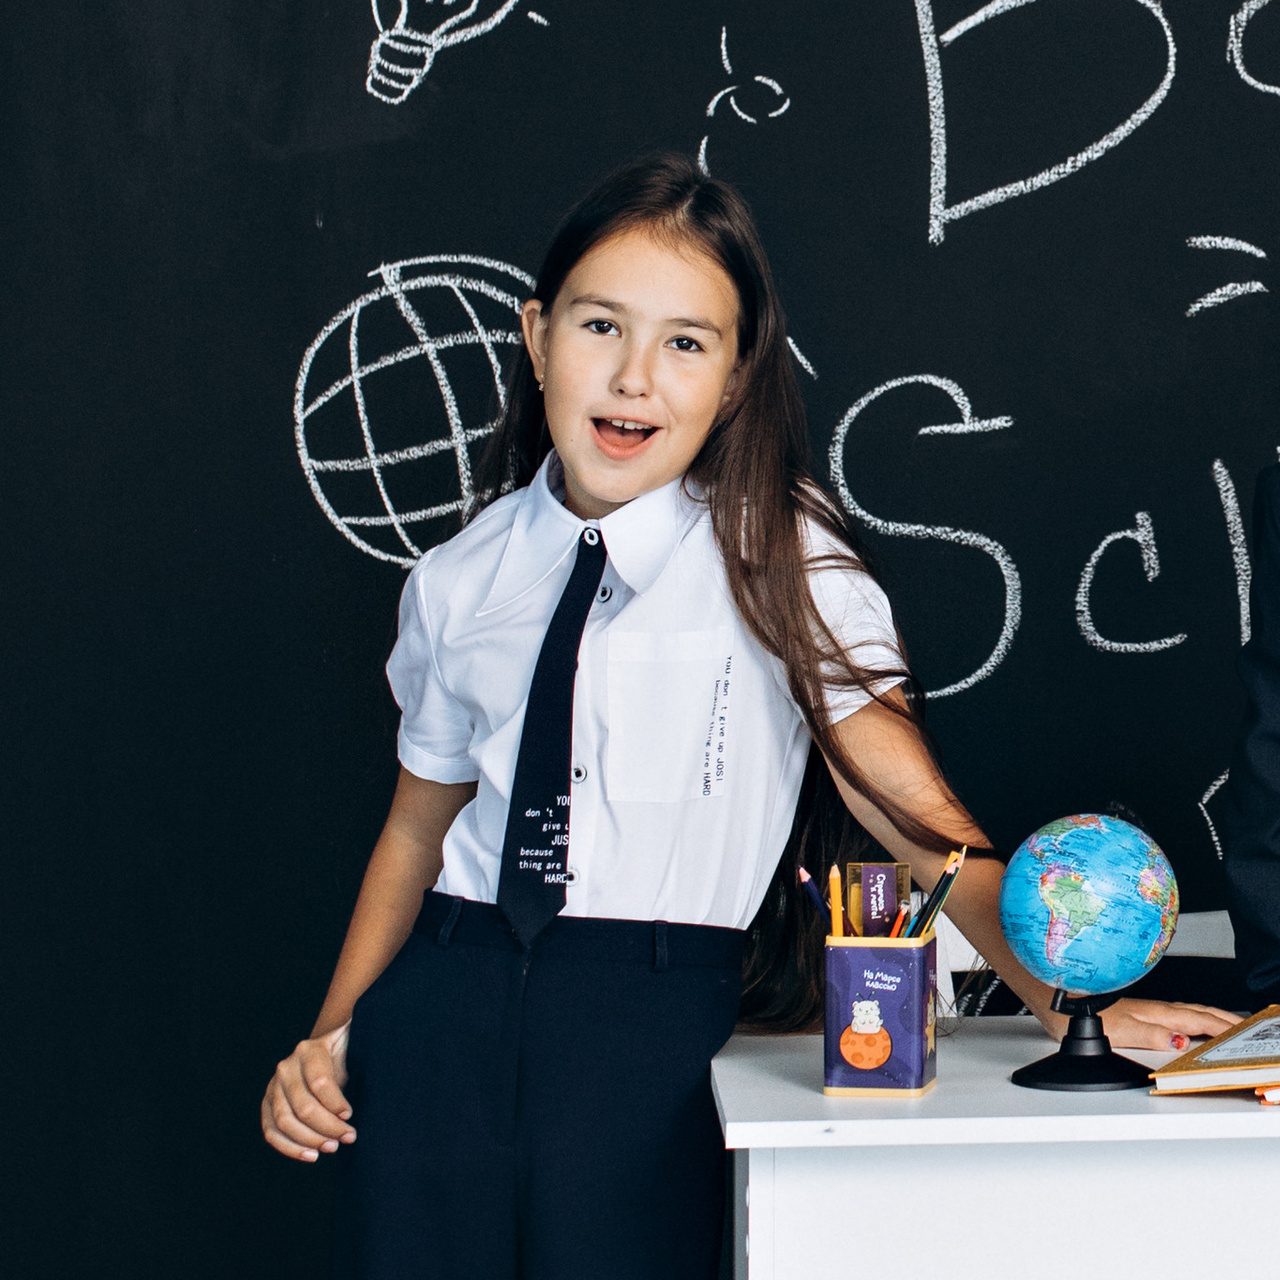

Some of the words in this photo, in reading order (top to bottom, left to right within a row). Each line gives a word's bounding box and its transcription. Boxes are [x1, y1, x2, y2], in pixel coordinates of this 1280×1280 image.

[719, 716, 727, 737] give
[717, 742, 724, 753] up
[702, 772, 711, 797] HARD
[542, 821, 561, 832] give
[551, 834, 569, 846] JUS
[520, 847, 554, 856] because
[519, 860, 542, 871] thing
[546, 862, 562, 870] are
[864, 969, 874, 980] На
[874, 971, 901, 985] Марсе
